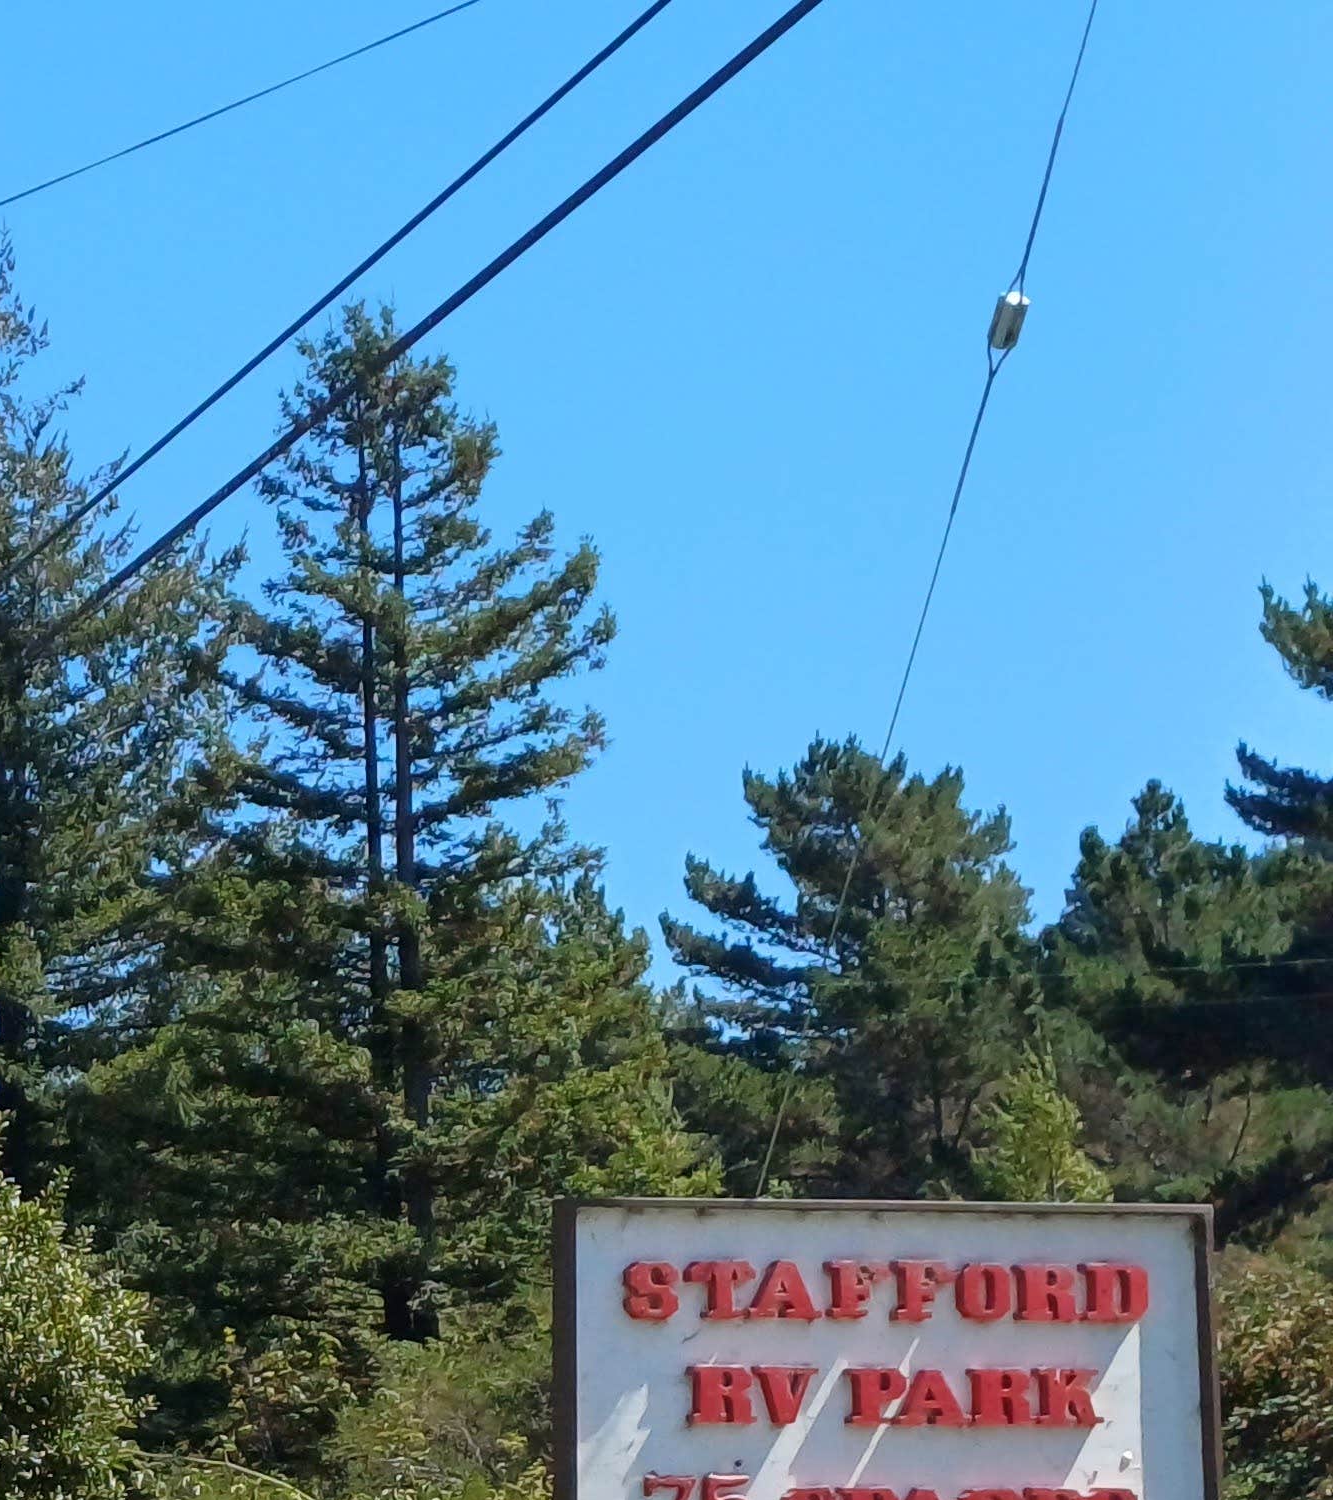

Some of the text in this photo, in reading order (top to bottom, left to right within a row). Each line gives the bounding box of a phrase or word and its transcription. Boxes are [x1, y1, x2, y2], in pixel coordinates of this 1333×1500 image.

[622, 1259, 1149, 1323] STAFFORD
[685, 1363, 1105, 1428] RV PARK
